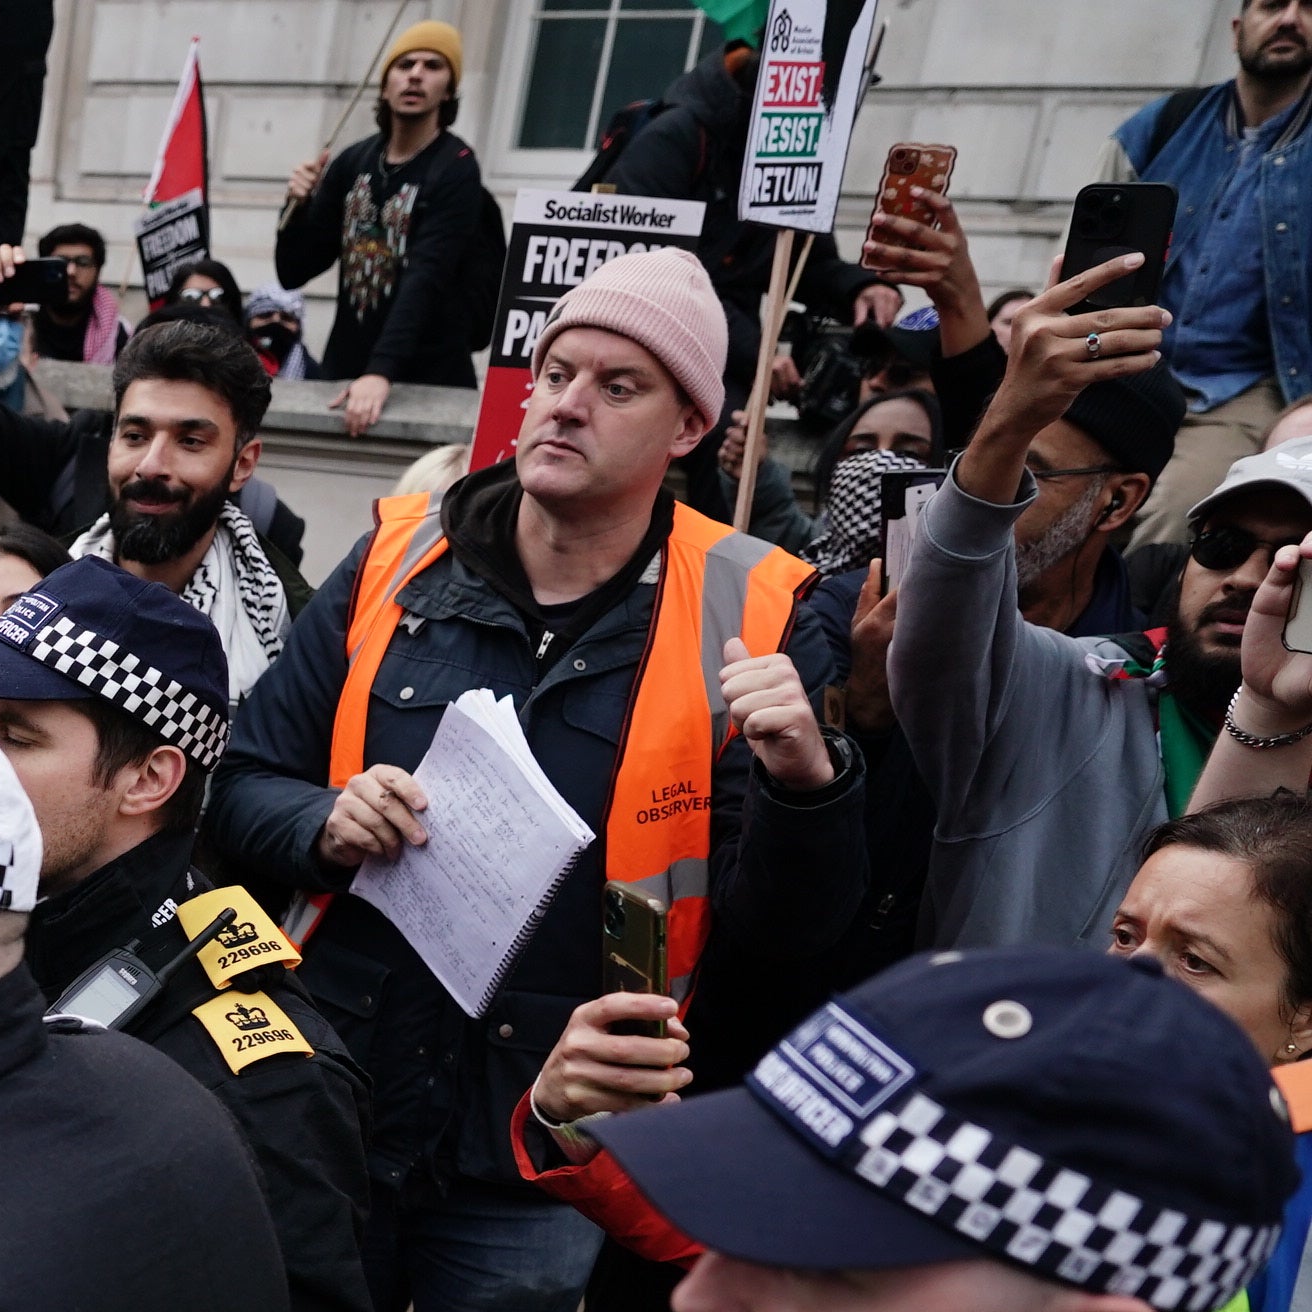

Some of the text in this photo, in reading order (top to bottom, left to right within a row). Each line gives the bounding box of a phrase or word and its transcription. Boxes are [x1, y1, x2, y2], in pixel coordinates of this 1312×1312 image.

[762, 65, 822, 103] EXIST.
[756, 116, 820, 153] RESIST.
[751, 166, 820, 203] RETURN.
[543, 199, 676, 228] Socialist Worker
[521, 235, 679, 286] FREE
[652, 780, 697, 803] LEGAL
[636, 796, 712, 825] OBSERVER
[217, 939, 283, 970] 229696
[231, 1028, 295, 1053] 229696
